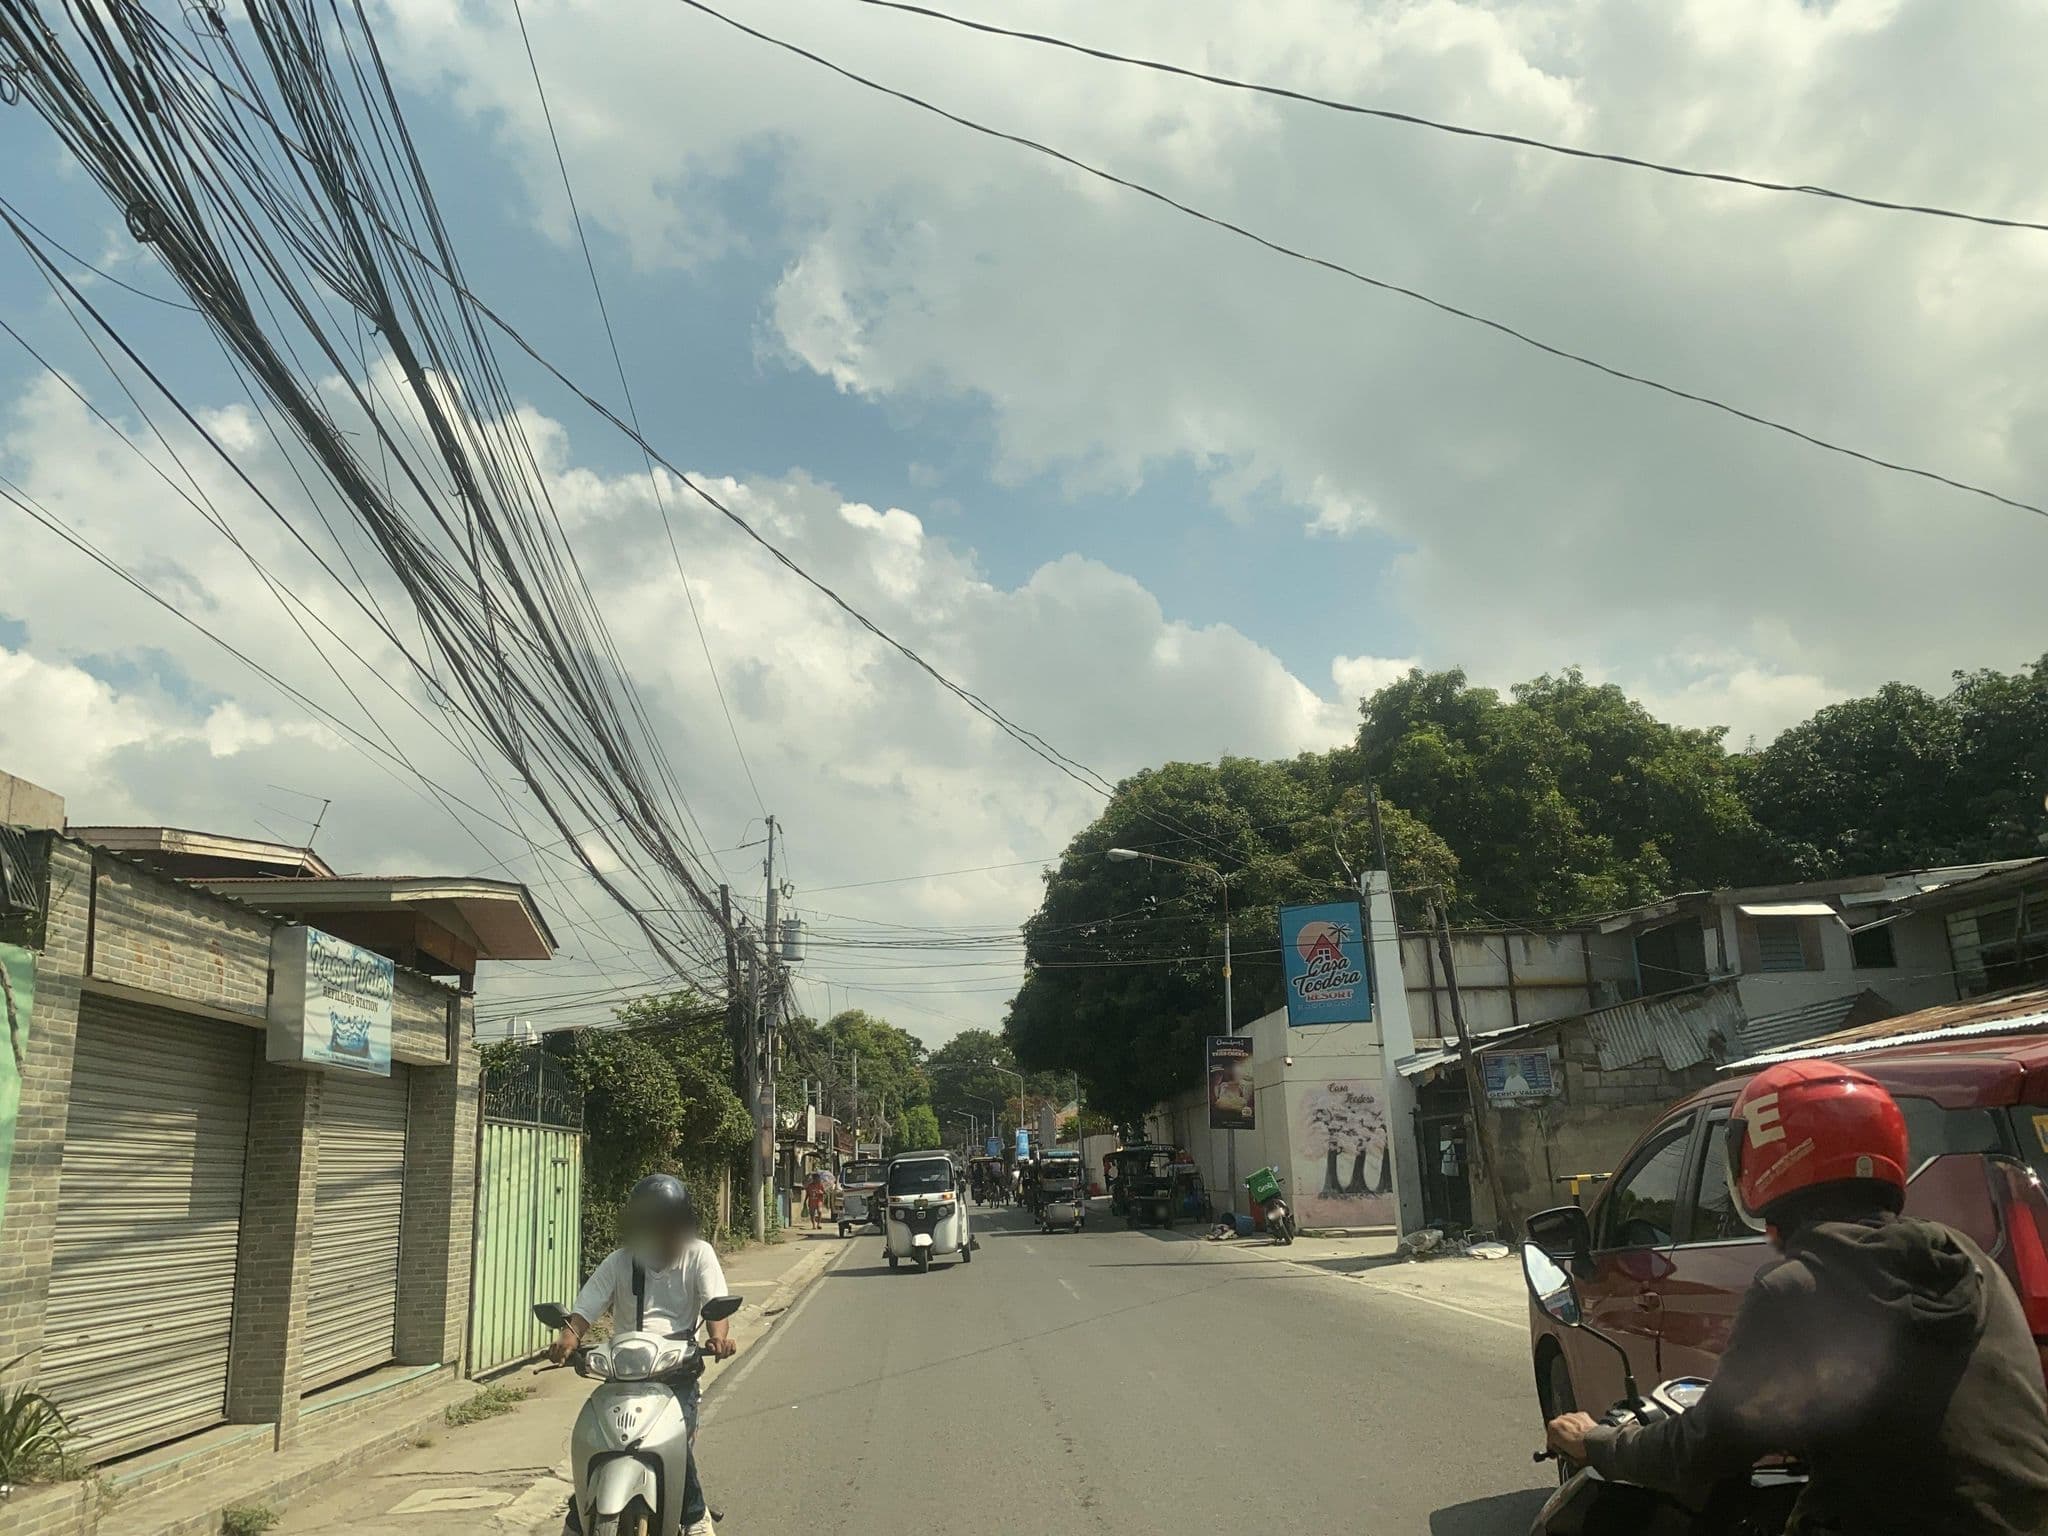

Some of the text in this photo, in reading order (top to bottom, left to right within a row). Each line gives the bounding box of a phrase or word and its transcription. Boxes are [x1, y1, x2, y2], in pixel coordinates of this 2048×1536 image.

[1308, 955, 1349, 977] Casa
[352, 959, 391, 1000] Water
[1293, 970, 1361, 996] Teodora
[323, 986, 379, 1013] REFILLING STATION
[1306, 989, 1354, 1001] RESORT
[1743, 1092, 1786, 1149] E
